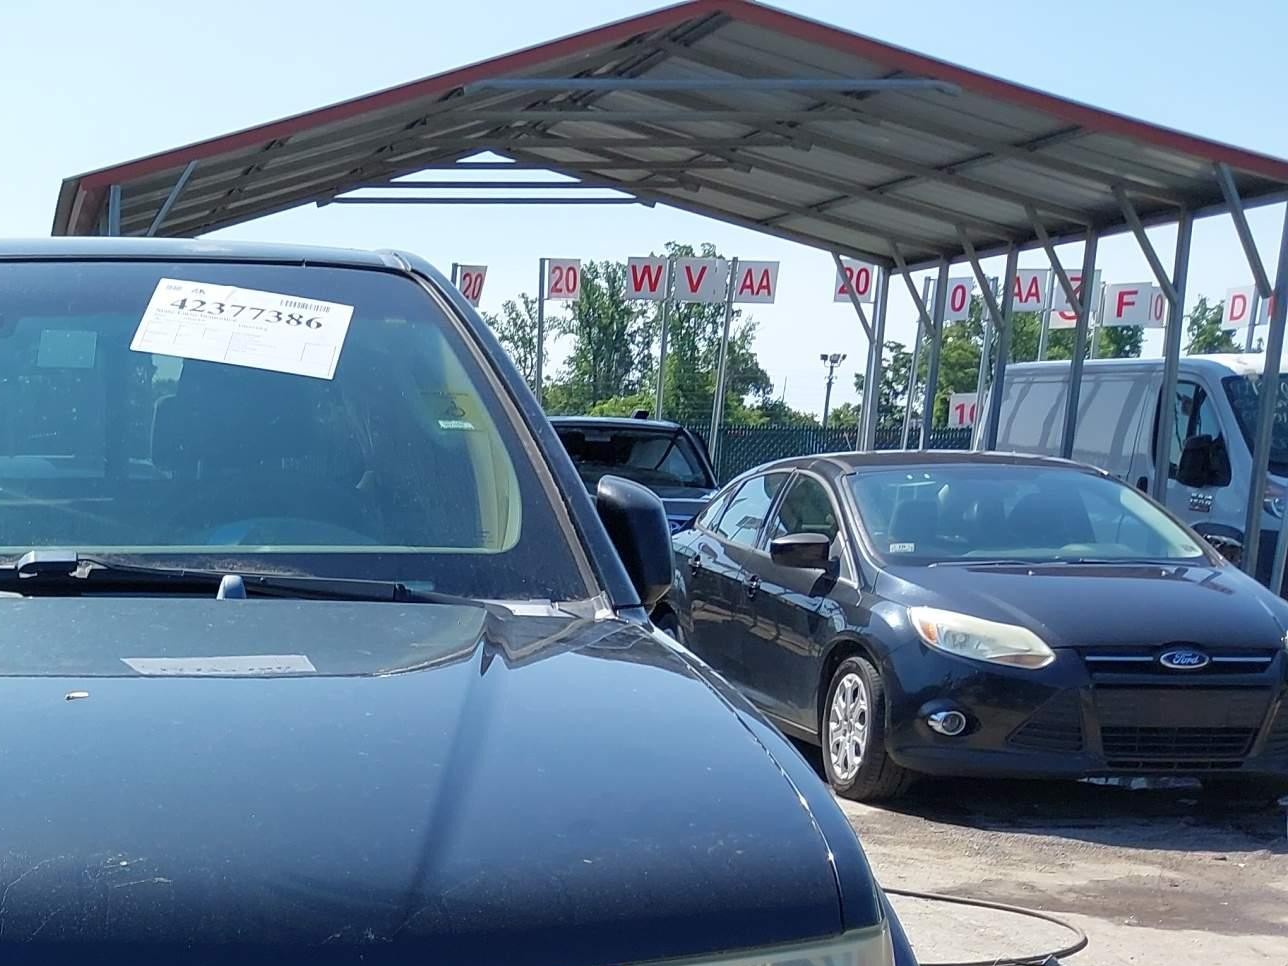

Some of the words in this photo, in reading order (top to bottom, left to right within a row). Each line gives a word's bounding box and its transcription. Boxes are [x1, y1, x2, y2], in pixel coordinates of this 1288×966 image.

[462, 272, 483, 300] 20
[550, 266, 577, 293] 20
[631, 264, 663, 292] W
[685, 265, 707, 293] V
[738, 267, 772, 296] AA
[169, 298, 323, 330] 42377386
[1116, 290, 1139, 318] F
[1229, 294, 1247, 321] D
[1173, 653, 1200, 665] Ford
